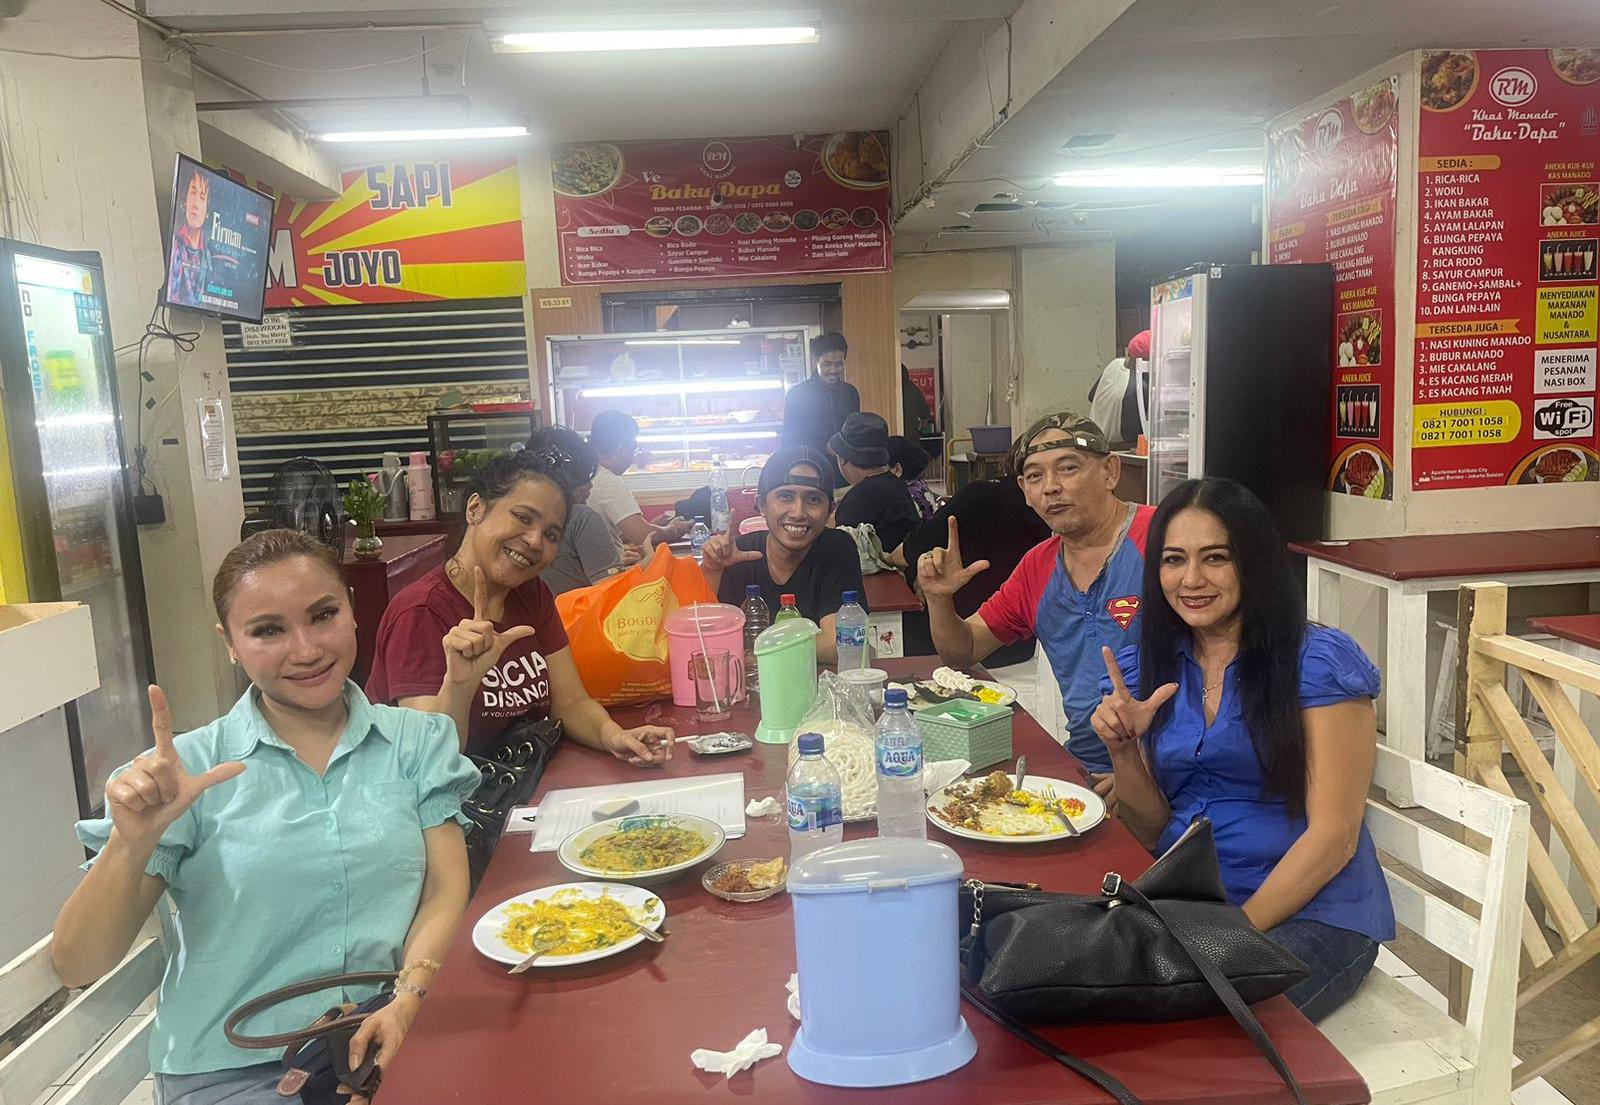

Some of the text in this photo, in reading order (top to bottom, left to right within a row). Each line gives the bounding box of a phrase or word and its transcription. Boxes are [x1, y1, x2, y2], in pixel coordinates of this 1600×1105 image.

[1472, 108, 1558, 120] Khas Manado
[1437, 158, 1468, 168] SEDIA
[1426, 174, 1480, 184] 1. RICA-RICA
[366, 162, 452, 210] SAPI
[650, 182, 712, 200] Baku
[1424, 186, 1464, 196] 2. WOKU
[1424, 198, 1489, 208] 3. IKAN BAKAR
[1424, 209, 1494, 220] 4. AYAM BAKAR
[210, 212, 242, 248] Firman
[1424, 221, 1504, 232] 5. AYAM LALAPAN
[1423, 233, 1503, 244] 6. BUNGA PEPAYA
[1432, 245, 1484, 256] KANGKUNG
[323, 250, 401, 286] JOYO
[1423, 257, 1482, 268] 7. RICA RODO
[1422, 268, 1503, 280] 8. SAYUR CAMPUR
[1422, 284, 1430, 292] 9.
[1432, 292, 1501, 303] BUNGA PEPAYA
[1540, 290, 1595, 300] MENYEDIAKAN
[1420, 304, 1500, 316] 10. DAN LAIN-LAIN
[1548, 300, 1586, 310] MAKANAN
[1550, 310, 1584, 320] MANADO
[1429, 323, 1498, 334] TERSEDIA JUGA
[1564, 321, 1569, 329] &
[1543, 330, 1590, 340] NUSANTARA
[1420, 336, 1531, 350] 1. NASI KUNING MANADO
[1420, 350, 1504, 362] 2. BUBUR MANADO
[1541, 354, 1590, 364] MENERIMA
[1420, 362, 1496, 374] 3. MIE CAKALANG
[1544, 366, 1586, 375] PESANAN
[1419, 373, 1513, 386] 4. ES KACANG MERAH
[1544, 377, 1586, 387] NASI BOX
[1419, 385, 1512, 398] 5. ES KACANG TANAH
[1440, 407, 1482, 418] HUBUNGI
[1422, 416, 1503, 429] 0821 7001 1058
[1421, 429, 1501, 441] 0821 7001 1058
[885, 750, 915, 765] AQUA
